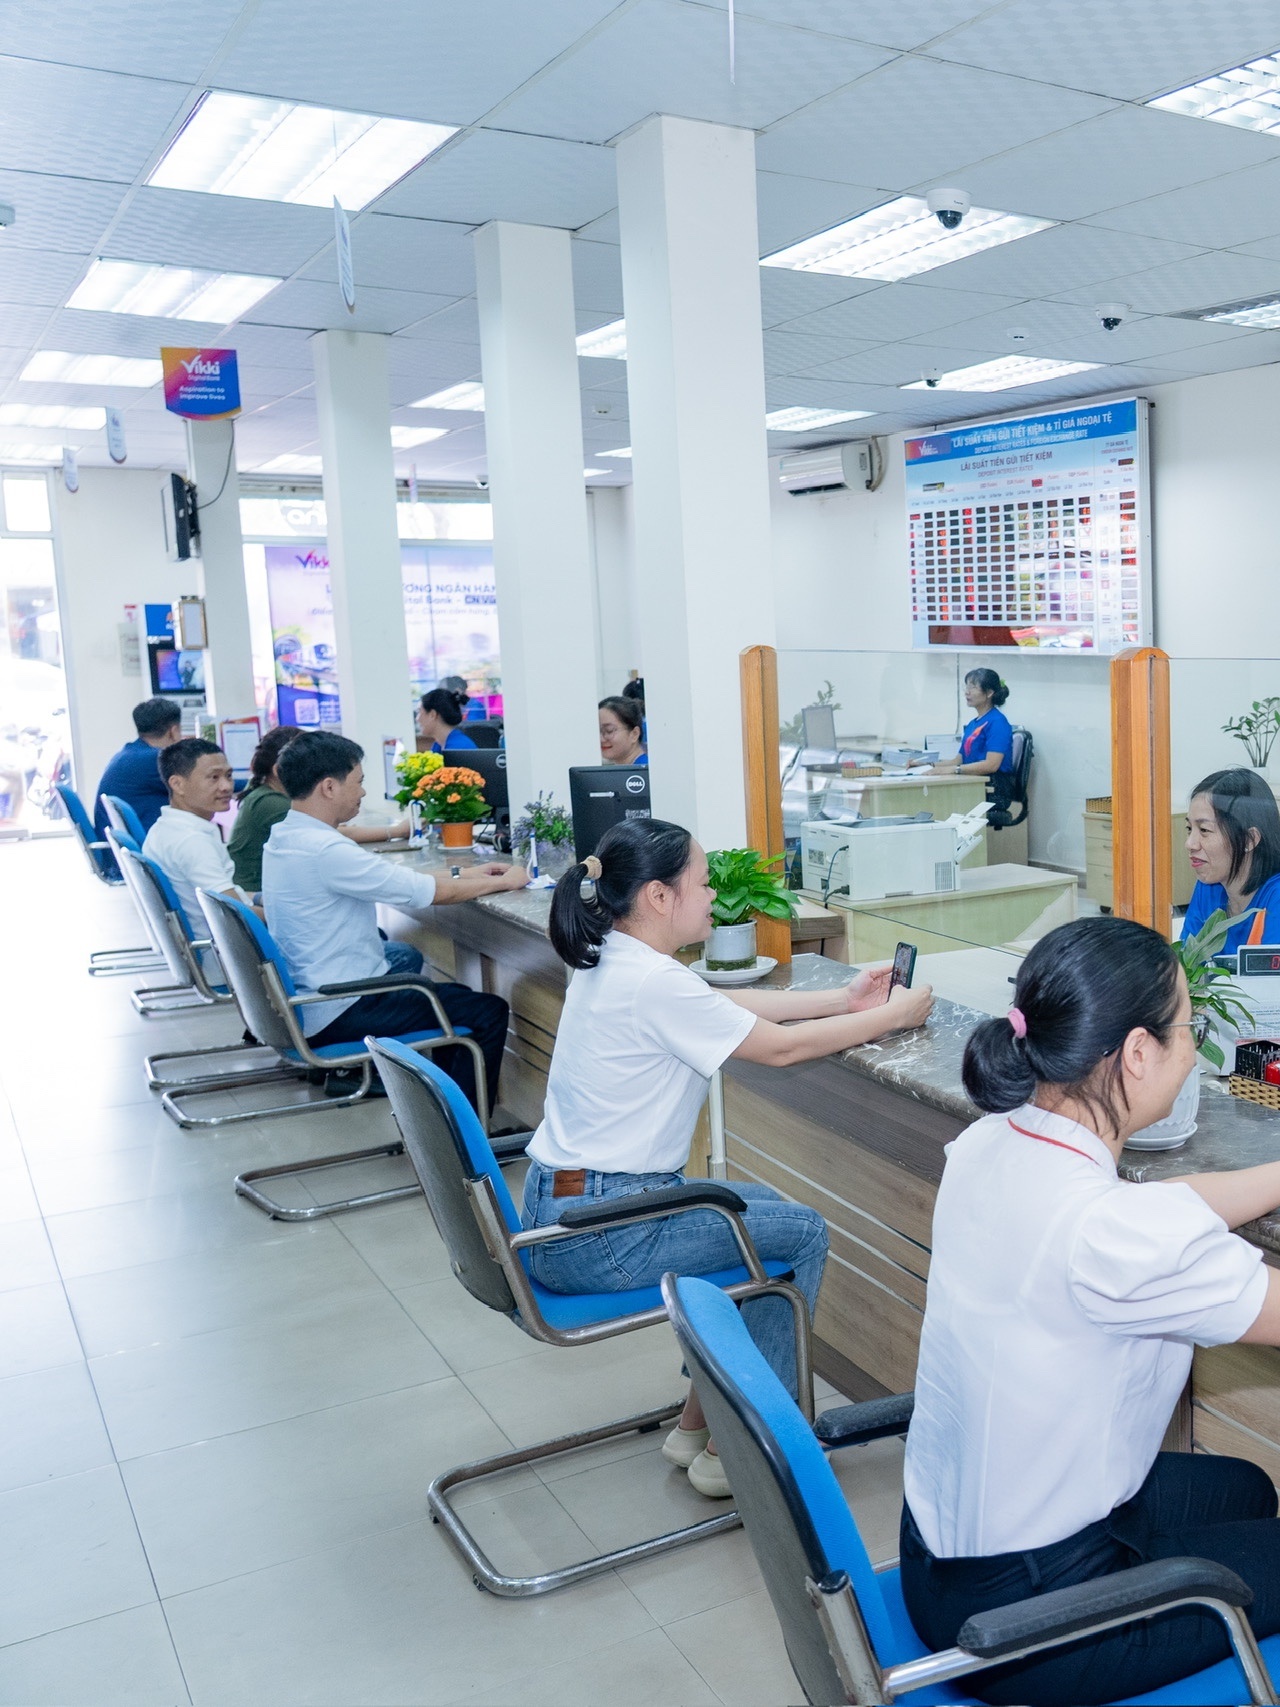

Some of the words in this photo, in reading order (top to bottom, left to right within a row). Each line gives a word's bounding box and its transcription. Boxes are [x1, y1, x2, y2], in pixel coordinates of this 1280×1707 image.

[181, 354, 220, 375] Vikki
[1062, 416, 1075, 429] GIÁ
[1076, 415, 1100, 427] NGOẠI
[1102, 411, 1112, 424] TỆ
[1271, 956, 1280, 969] 0
